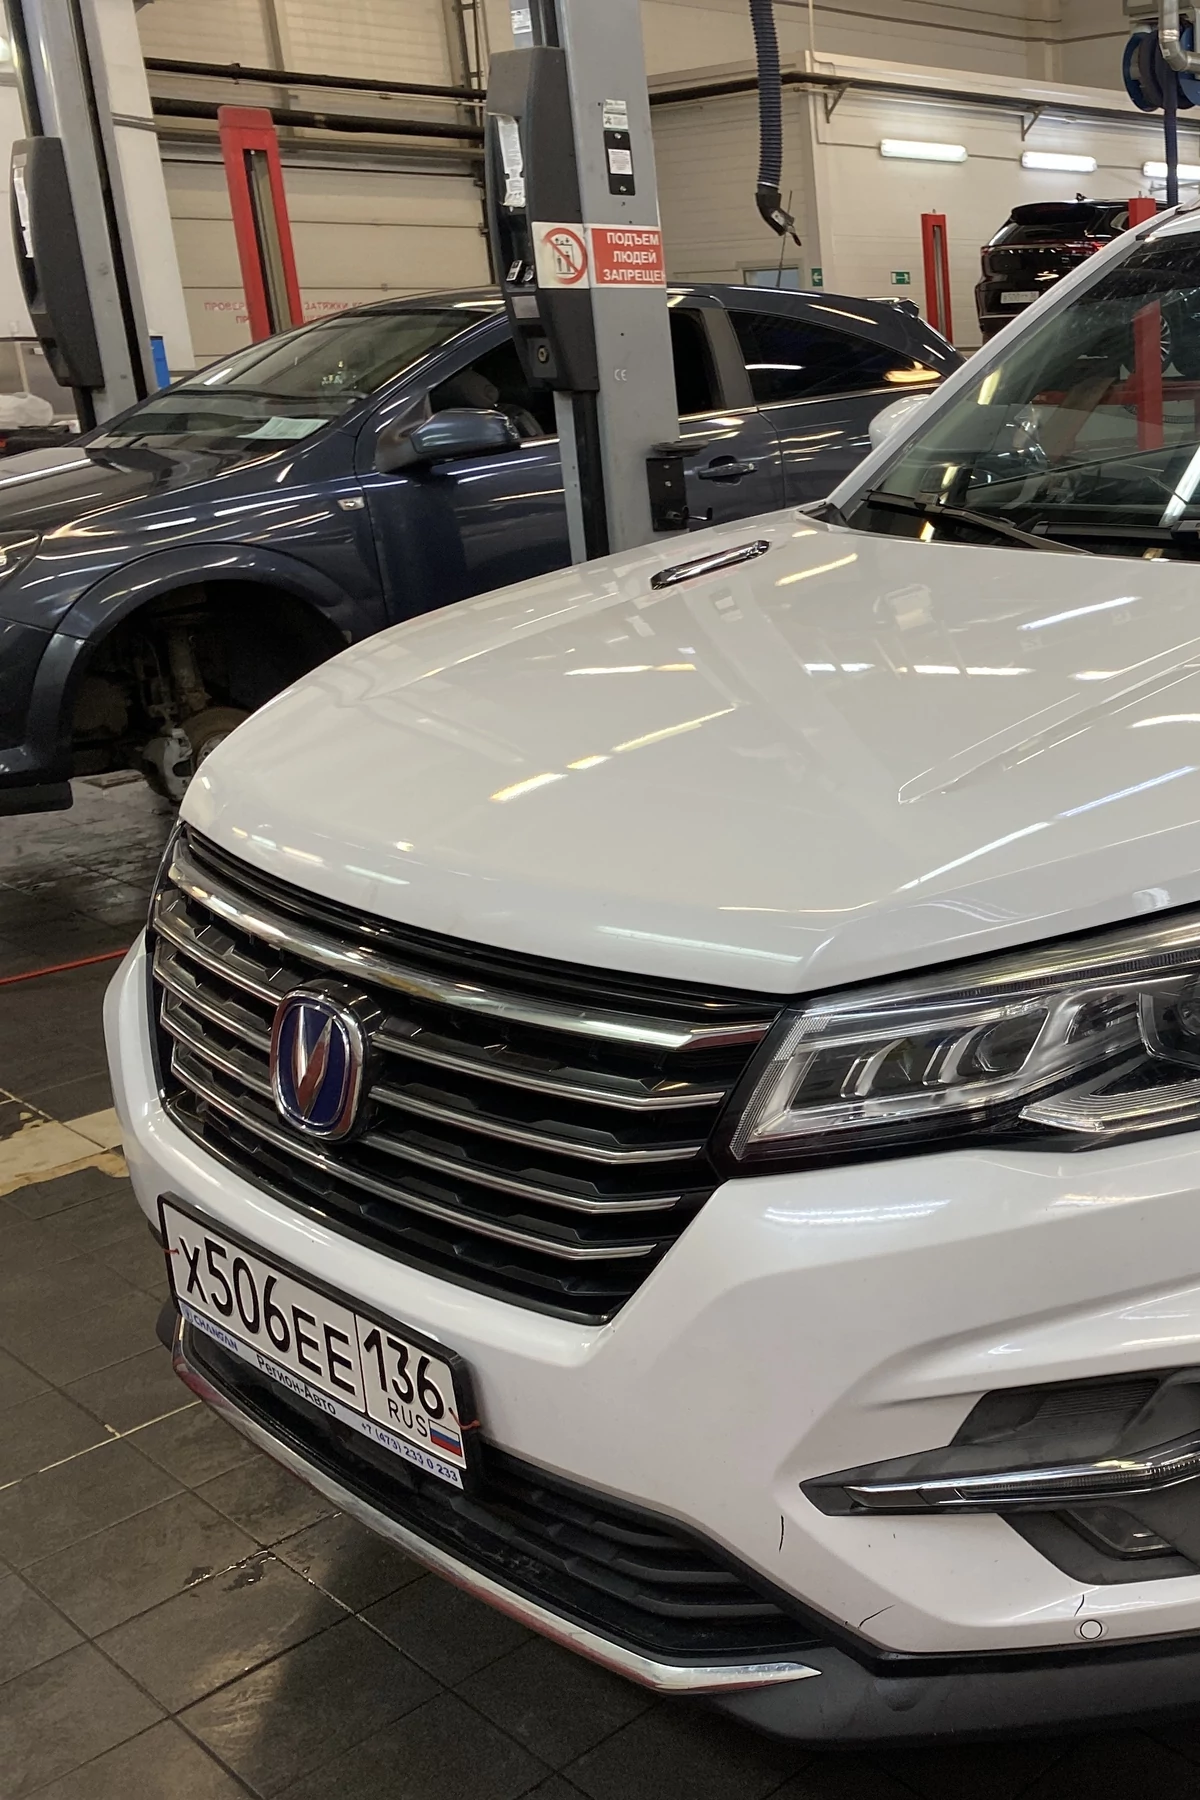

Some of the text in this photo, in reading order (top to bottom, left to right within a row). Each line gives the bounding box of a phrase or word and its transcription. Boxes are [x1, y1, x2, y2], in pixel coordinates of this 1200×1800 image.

[606, 232, 660, 247] ПОДЪЕМ
[613, 249, 657, 265] ЛЮДЕЙ
[203, 302, 246, 311] ПРОВЕР
[194, 1314, 239, 1352] CHANGAN
[256, 1354, 337, 1416] Регион-Авто
[363, 1328, 445, 1420] 136
[387, 1397, 429, 1438] RUS
[361, 1422, 458, 1482] +7 (473) 233 0 233
